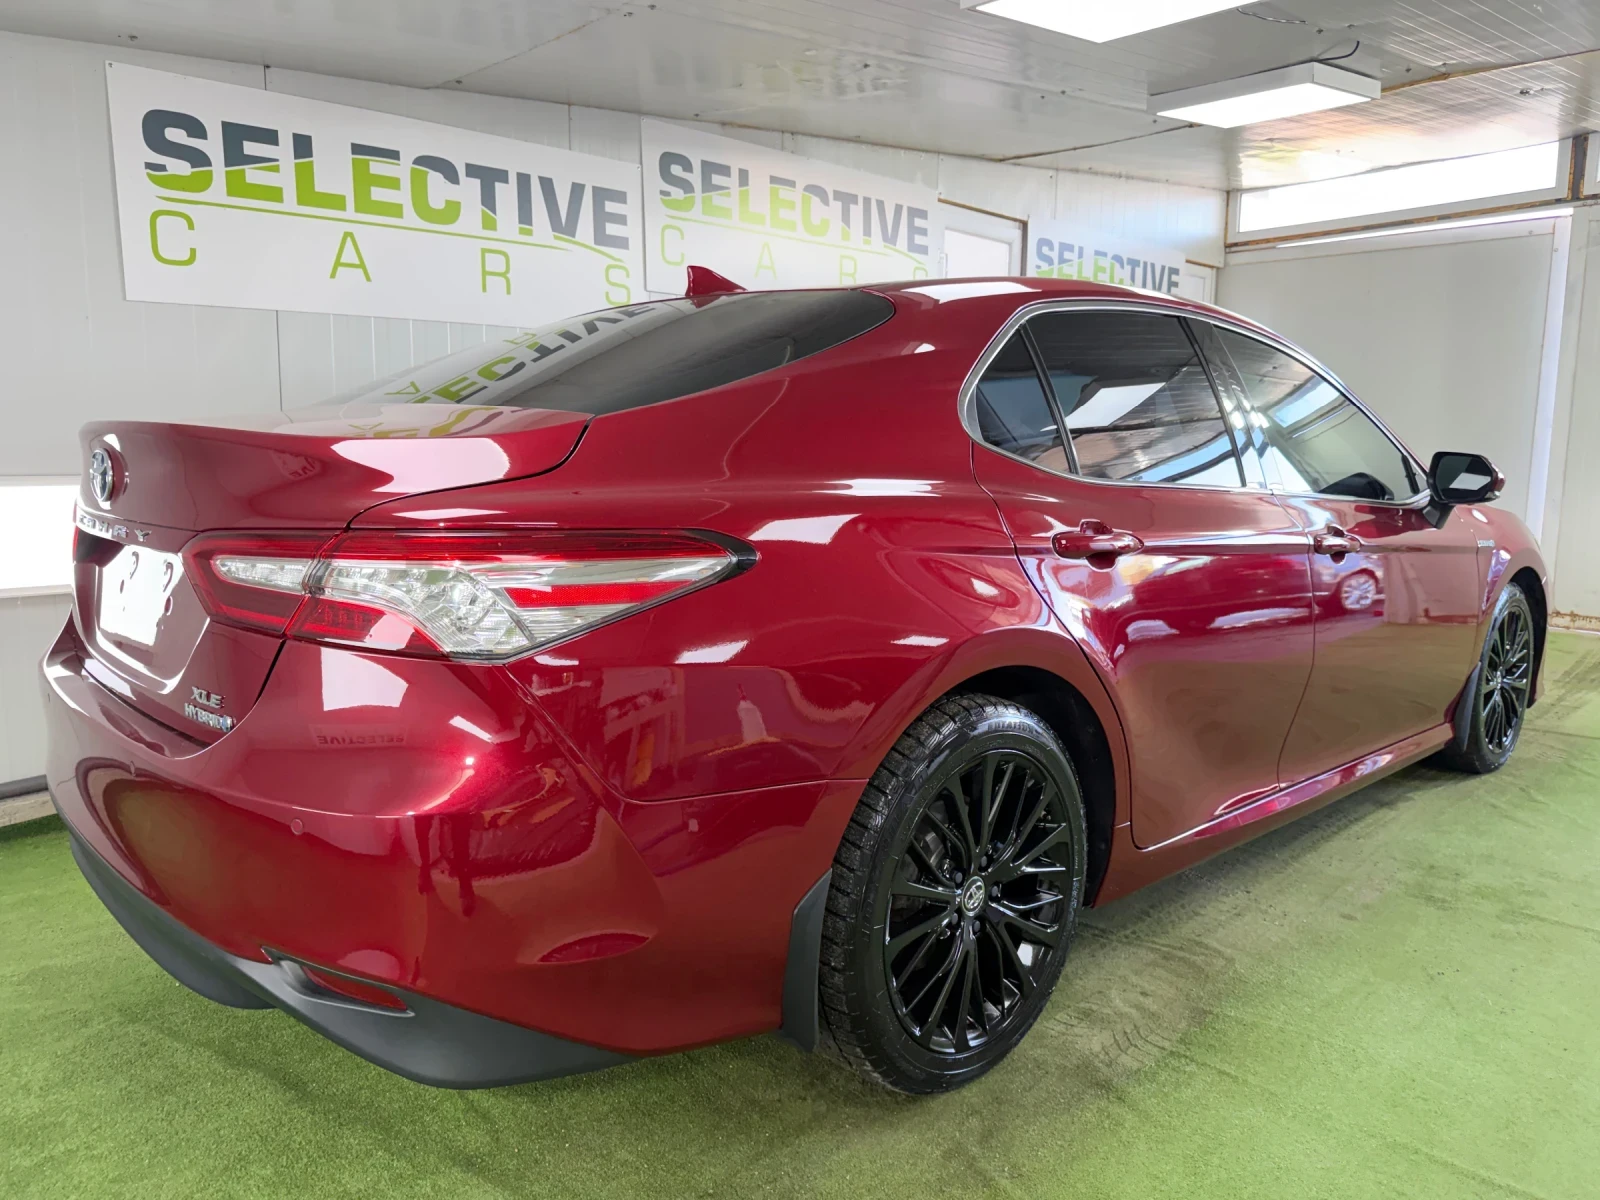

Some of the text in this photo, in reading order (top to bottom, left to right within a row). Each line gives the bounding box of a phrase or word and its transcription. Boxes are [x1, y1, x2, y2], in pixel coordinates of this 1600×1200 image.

[142, 109, 630, 250] SELECTIVE
[658, 151, 930, 256] SELECTIVE
[1035, 237, 1181, 294] SELECTIVE
[184, 702, 233, 732] HYBRID
[191, 686, 223, 709] XLE
